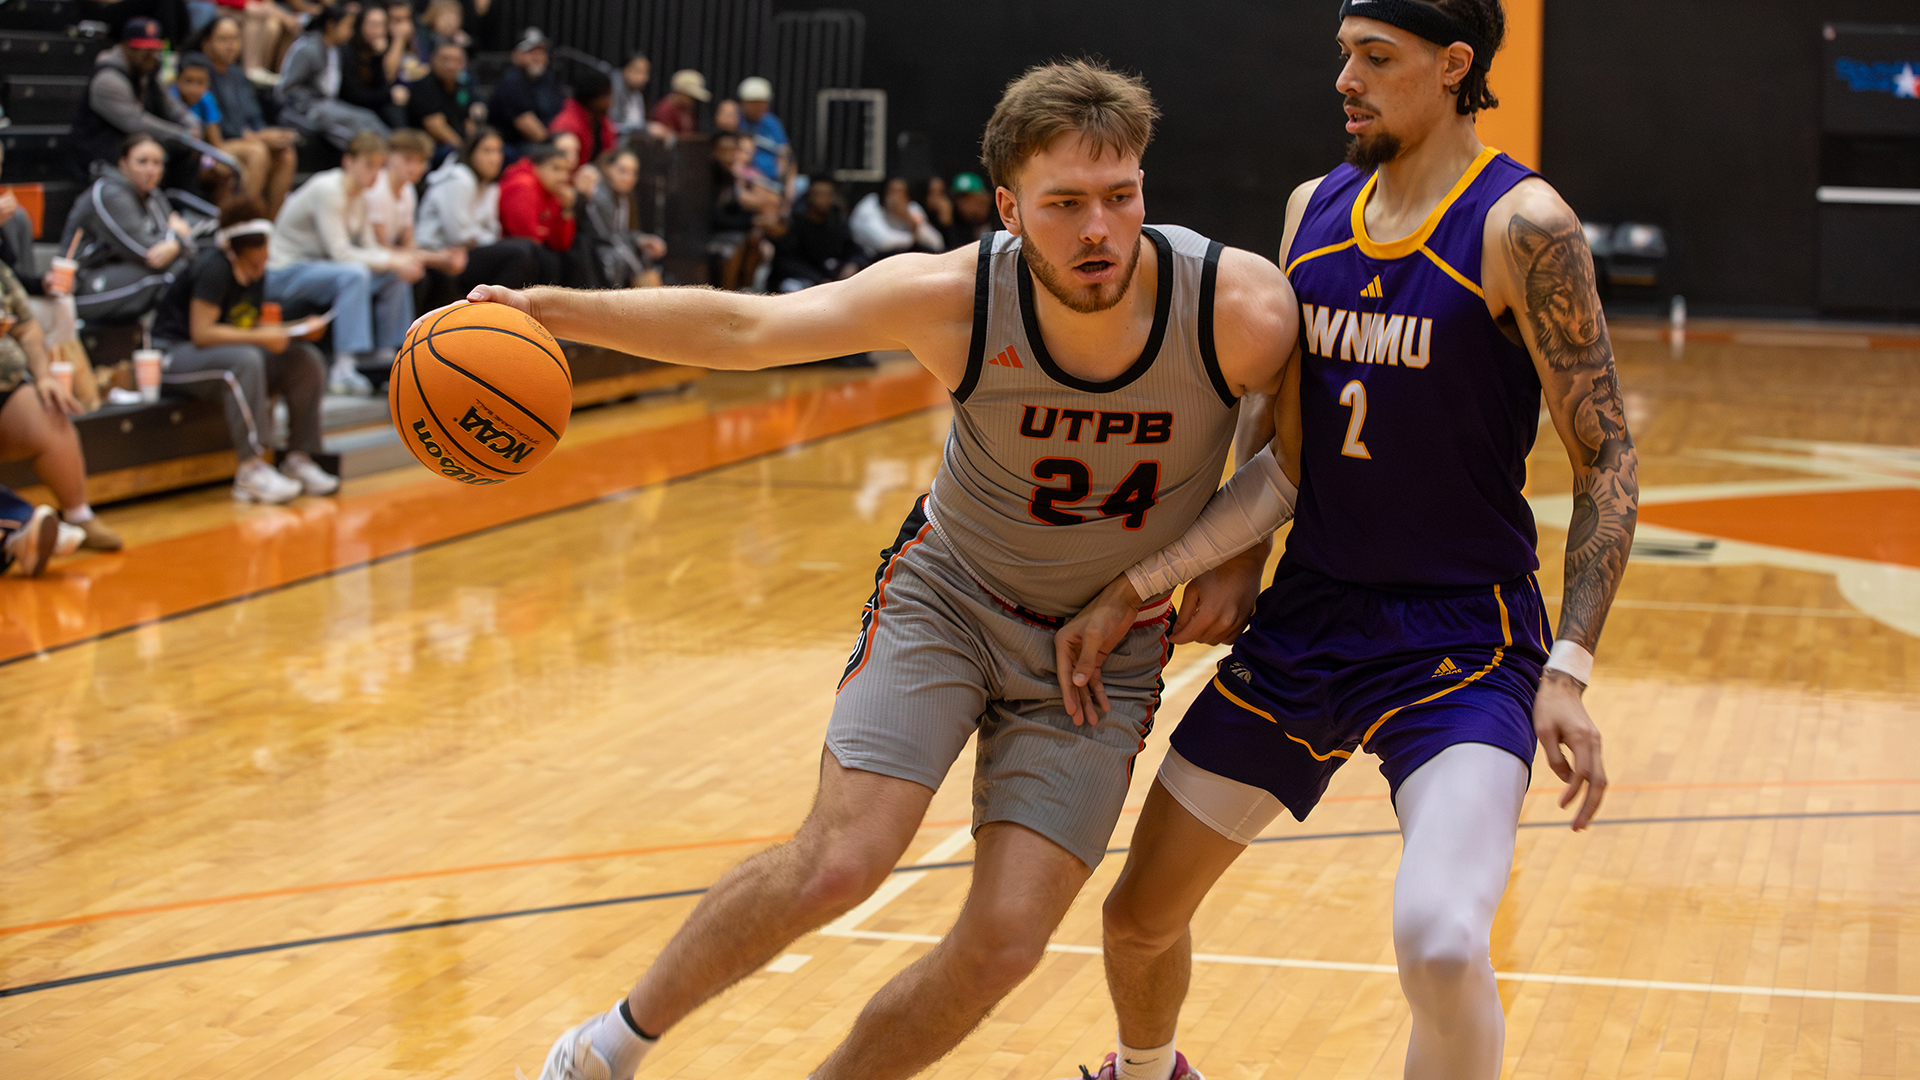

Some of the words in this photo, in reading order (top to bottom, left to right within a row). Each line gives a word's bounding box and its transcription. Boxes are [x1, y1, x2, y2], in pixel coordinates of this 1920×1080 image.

[1302, 303, 1433, 369] WNMU
[458, 405, 535, 464] NCAA
[1019, 403, 1174, 445] UTPB
[1339, 379, 1372, 460] 2
[1028, 456, 1161, 531] 24
